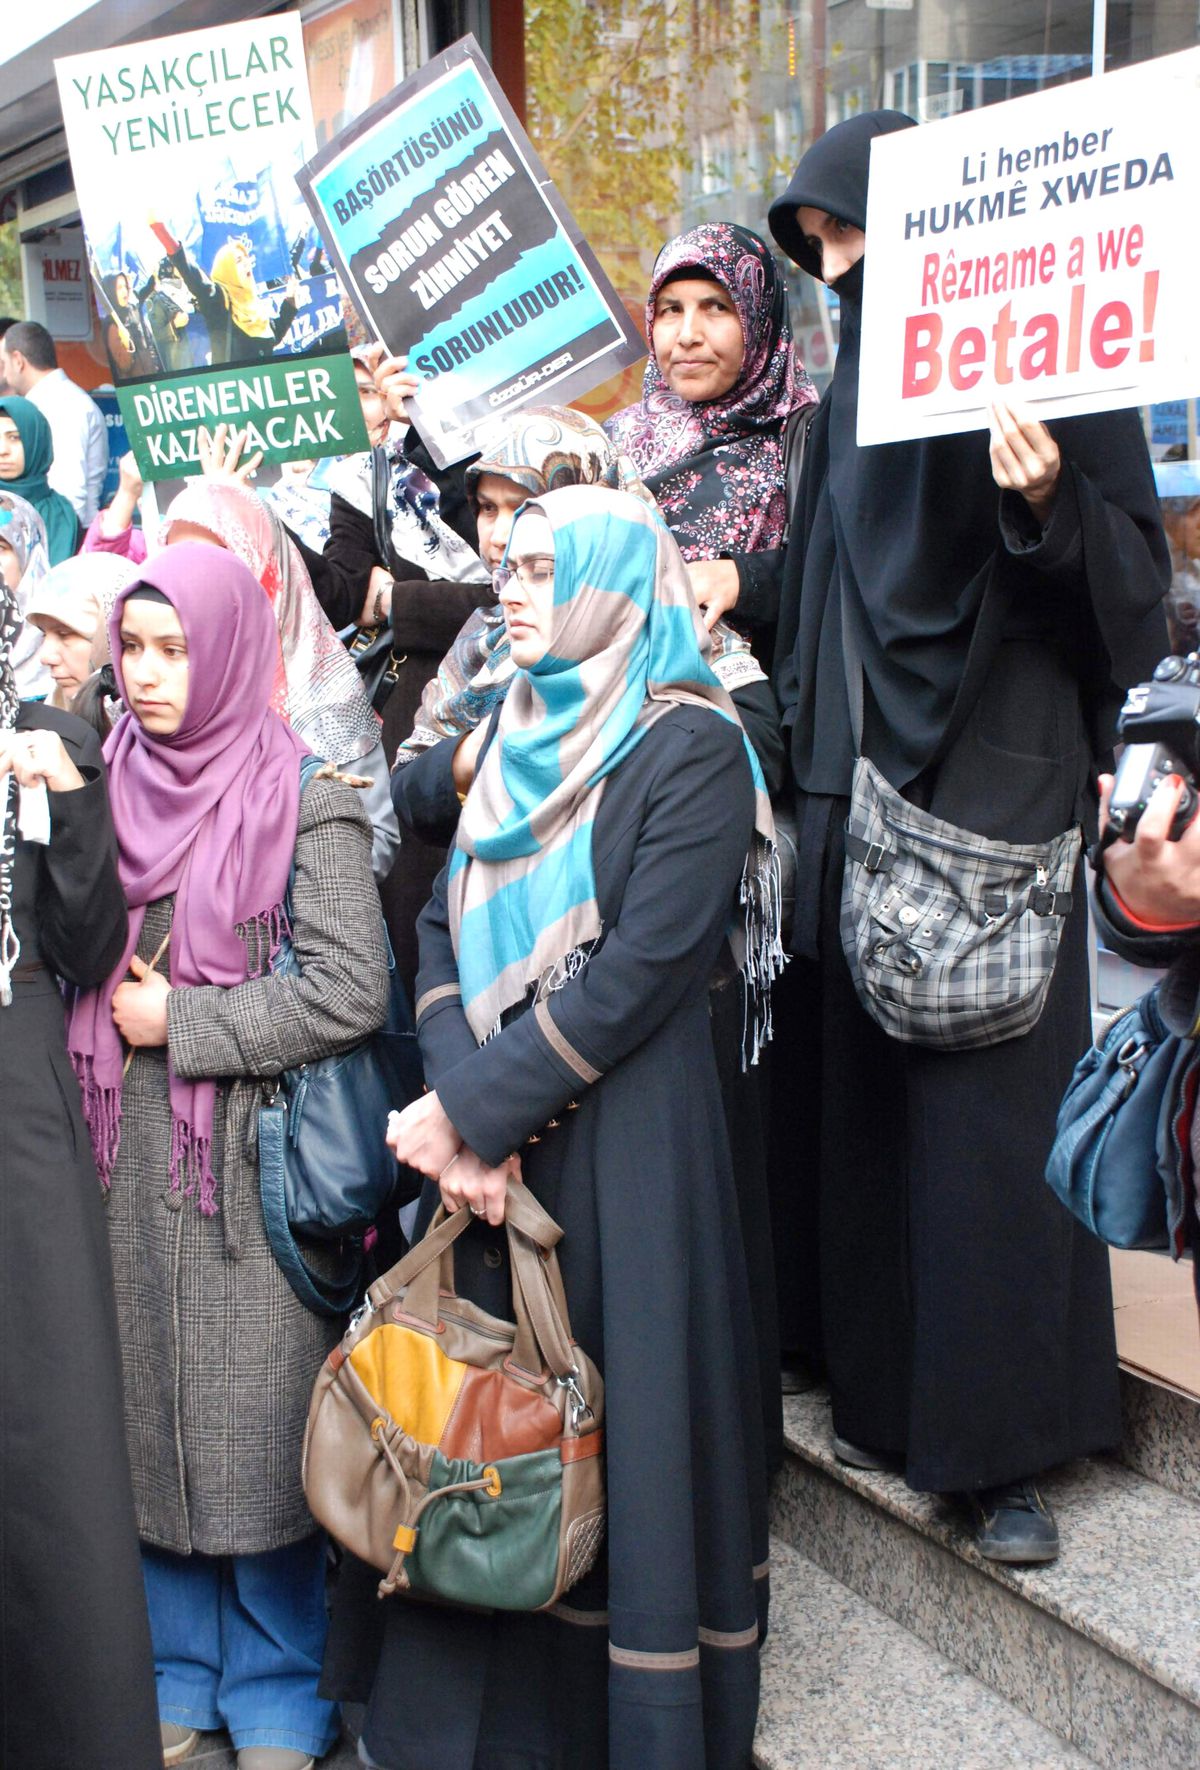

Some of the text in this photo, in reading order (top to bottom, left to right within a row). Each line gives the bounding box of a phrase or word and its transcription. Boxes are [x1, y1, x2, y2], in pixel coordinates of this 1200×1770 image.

[72, 36, 294, 110] YASAKÇILAR
[102, 87, 300, 155] YENİLECEK
[333, 97, 485, 226] BAŞÖRTÜSÜNÜ
[962, 127, 1113, 185] Li hember
[364, 149, 516, 294] SORUN GÖREN
[904, 152, 1174, 240] HUKMÊ XWEDA
[409, 209, 514, 311] ZİHNİYET
[921, 223, 1144, 307] Rêzname a we
[415, 264, 586, 382] SORUNLUDUR!
[901, 270, 1160, 399] Betale!
[133, 368, 337, 427] DİRENENLER
[146, 409, 345, 466] KAZACAK
